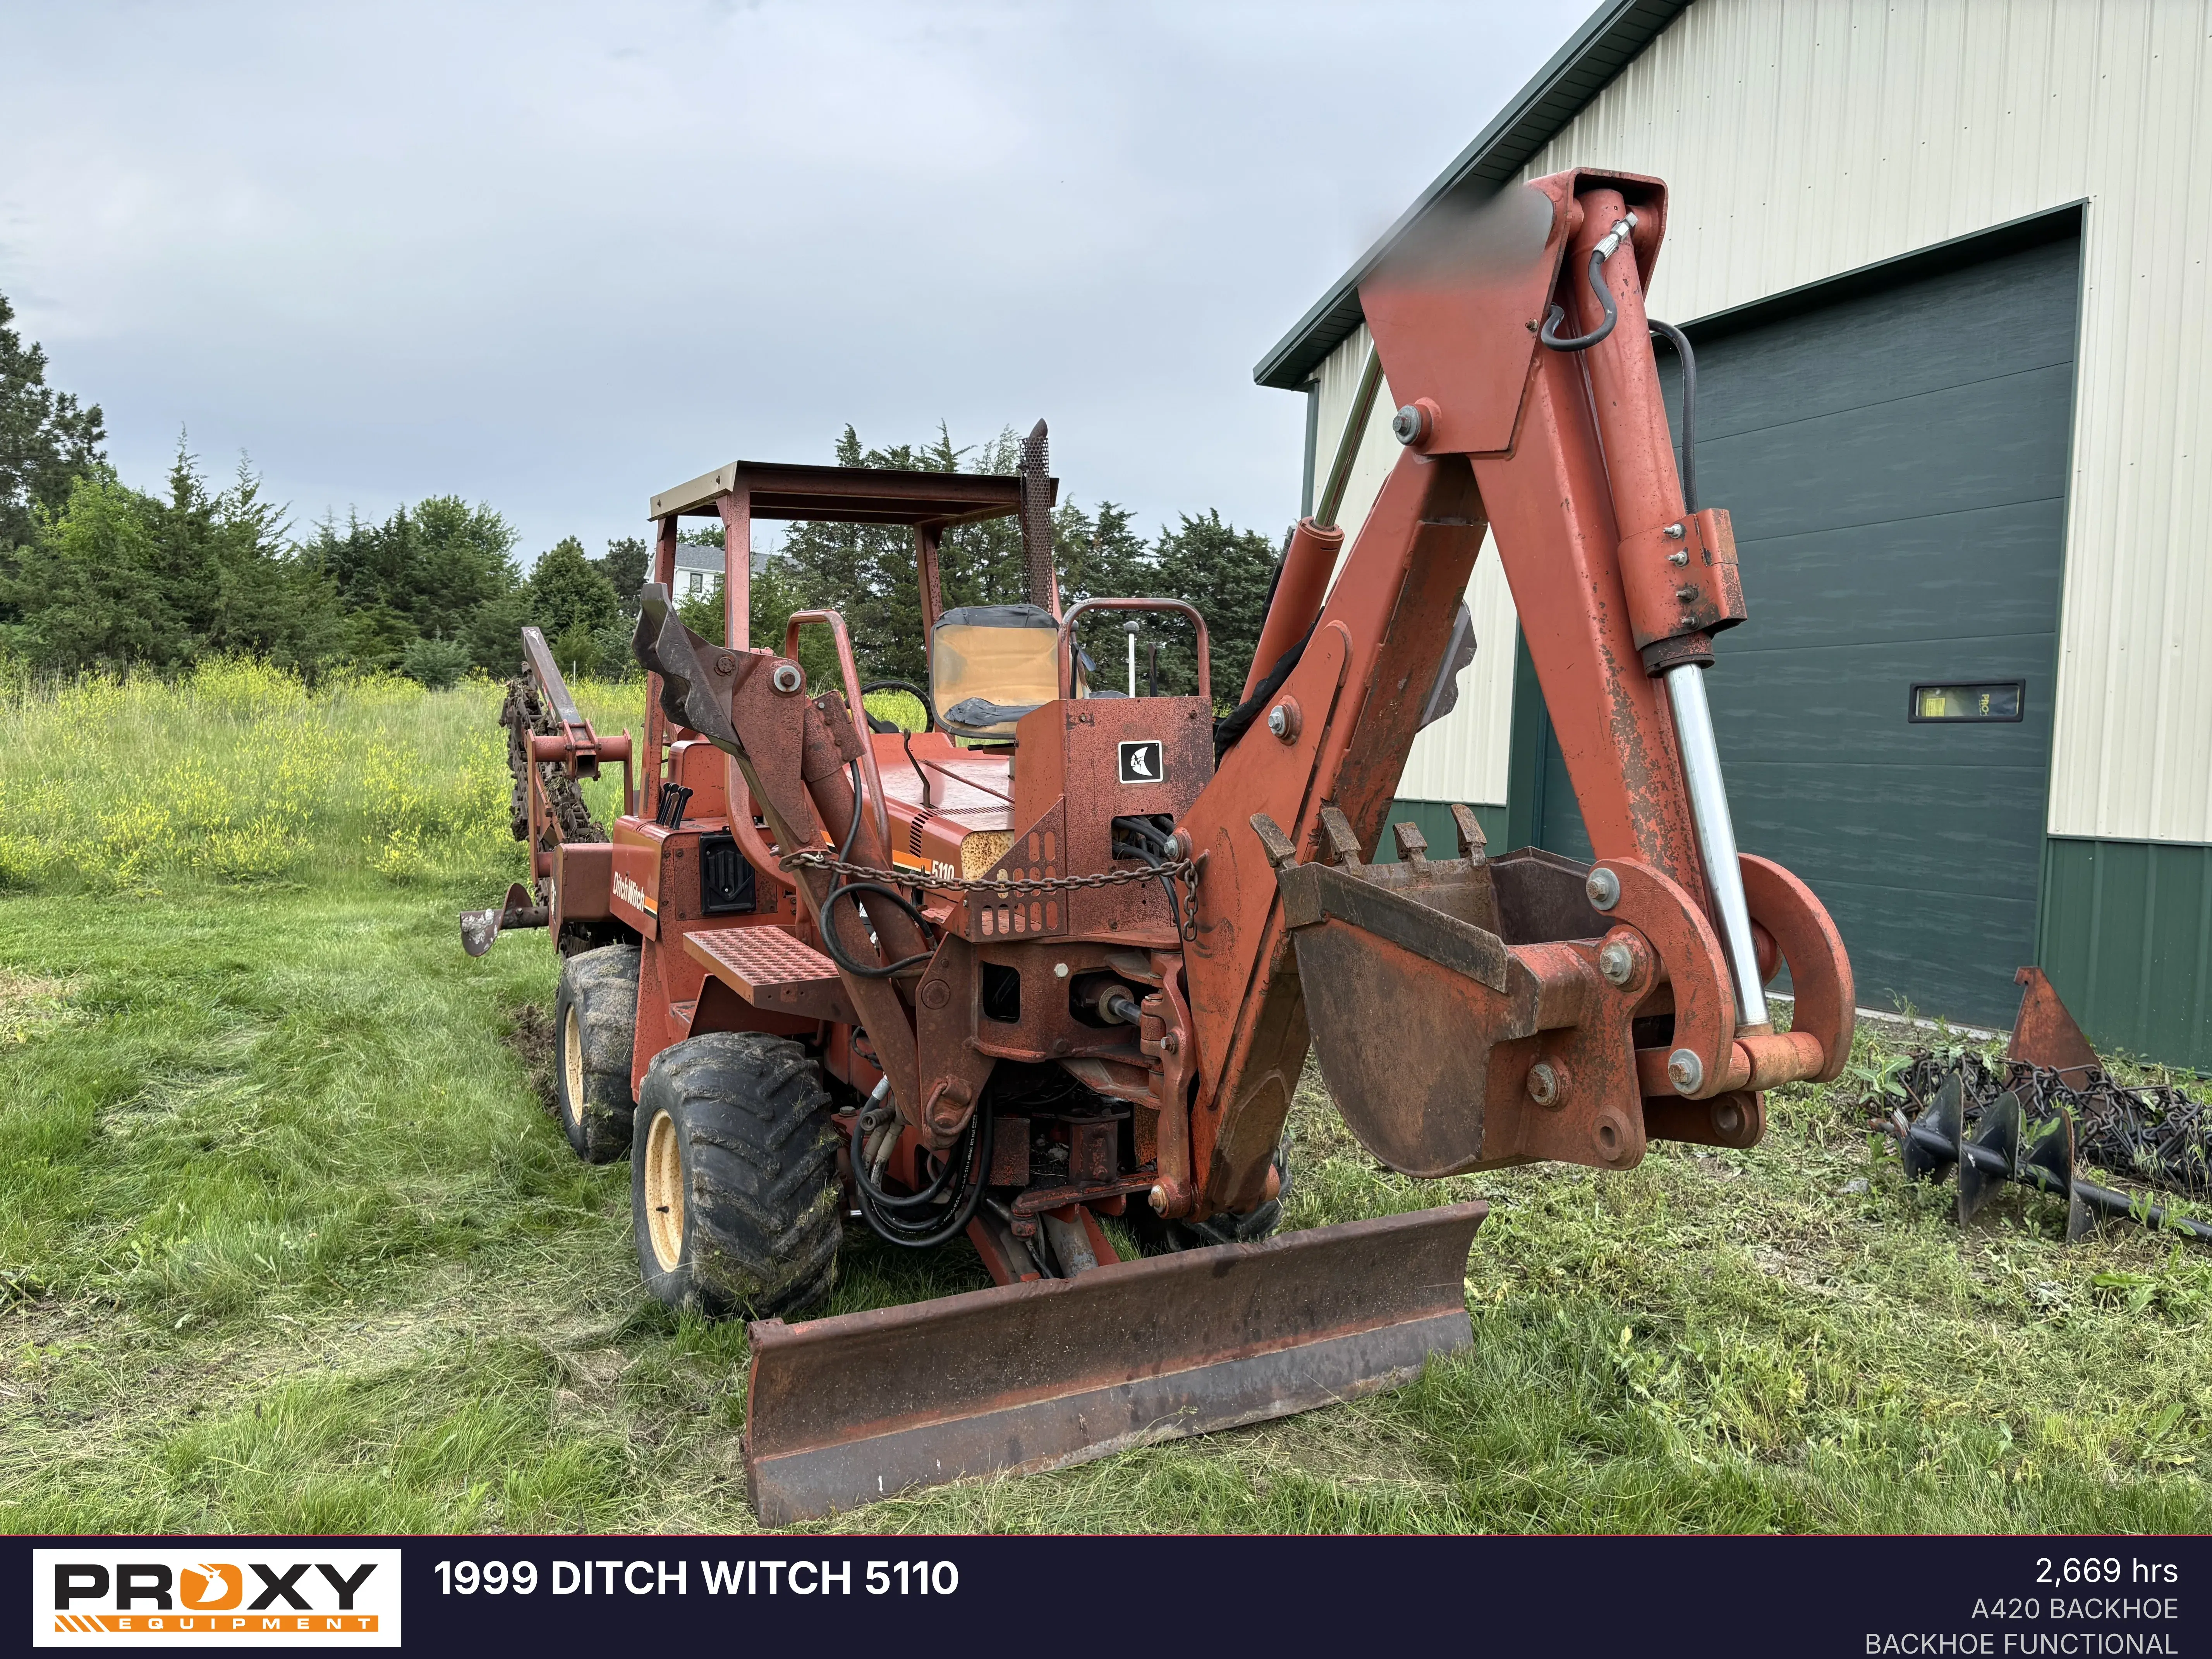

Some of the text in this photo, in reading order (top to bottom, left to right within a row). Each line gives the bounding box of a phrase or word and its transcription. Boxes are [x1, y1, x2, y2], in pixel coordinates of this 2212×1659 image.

[932, 860, 955, 884] 5110
[613, 871, 645, 912] Ditch Witch
